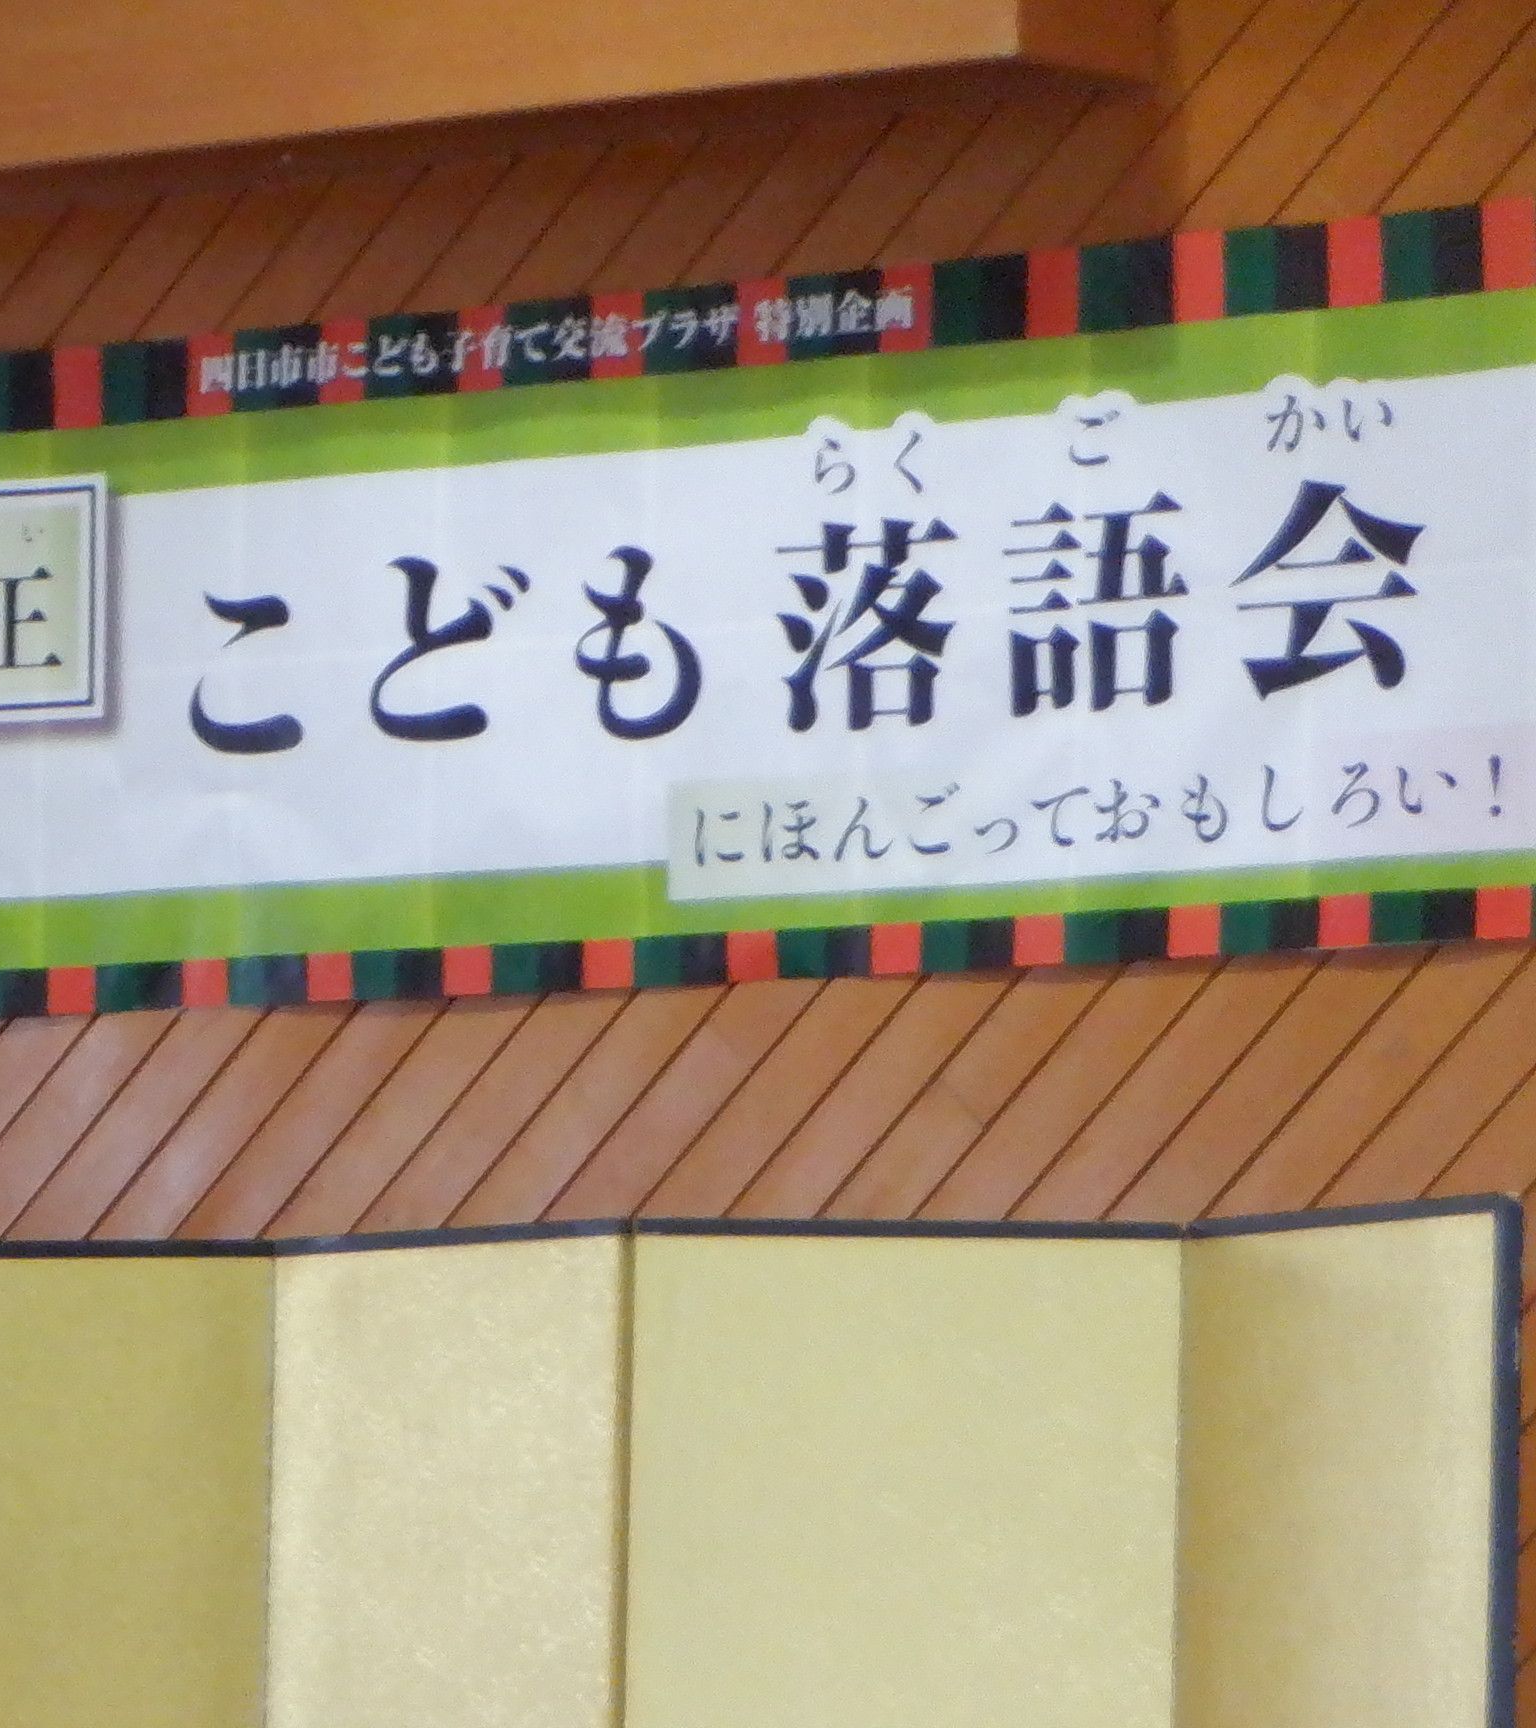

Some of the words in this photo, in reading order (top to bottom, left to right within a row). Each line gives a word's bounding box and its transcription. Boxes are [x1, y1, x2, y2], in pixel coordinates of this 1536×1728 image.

[198, 304, 740, 394] 四日市市こども子育て交流プラザ
[754, 285, 915, 344] 特別企画
